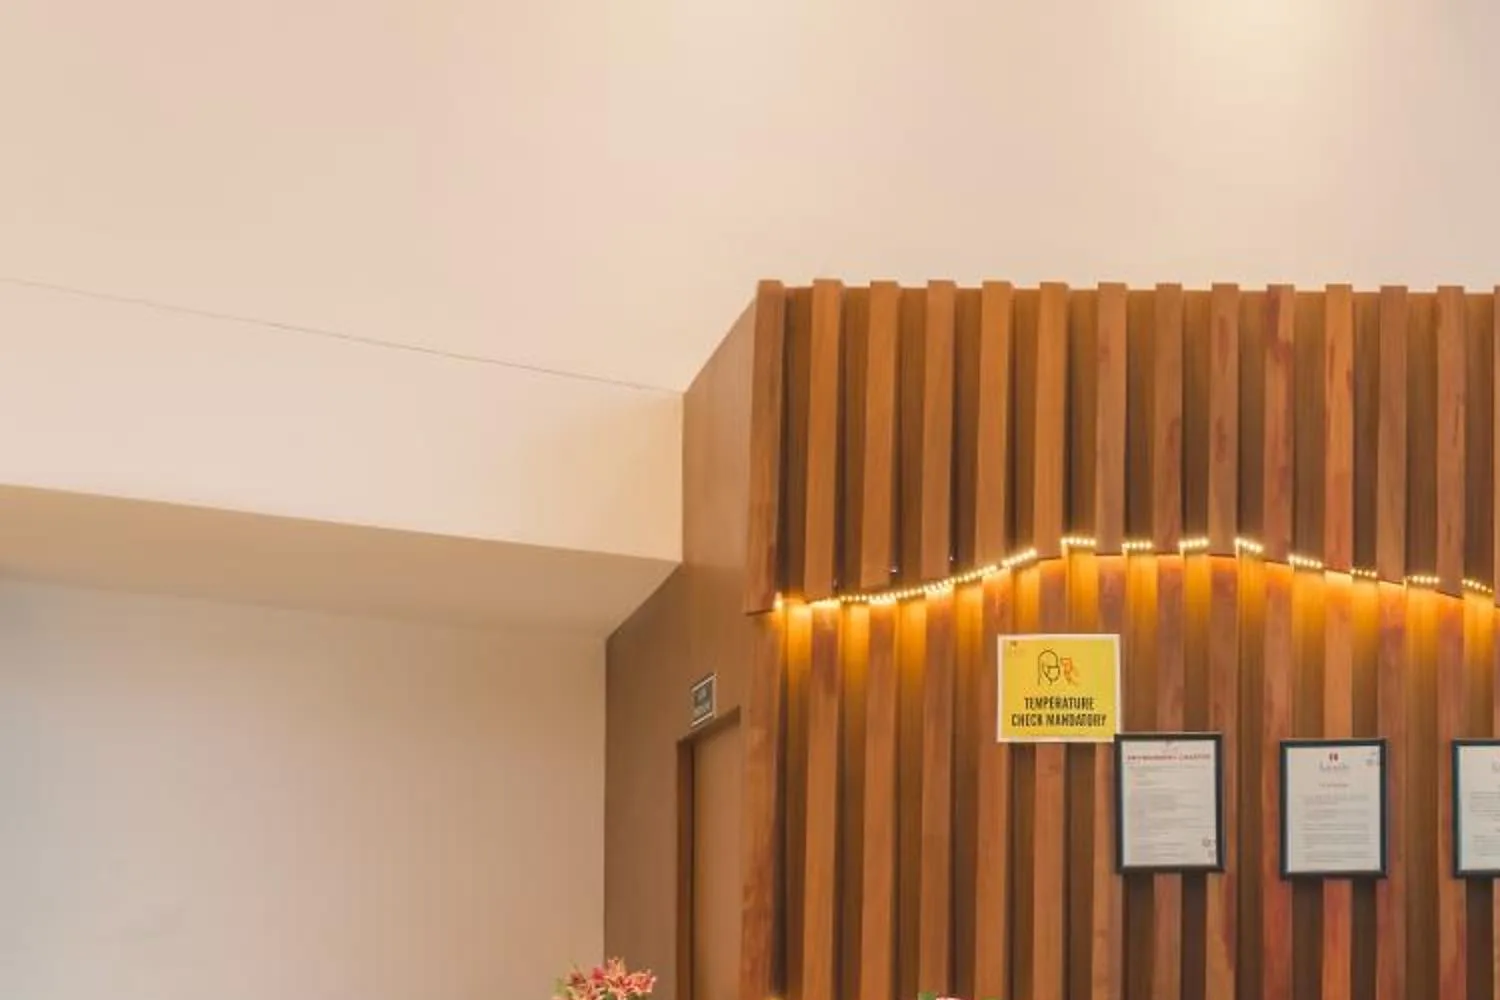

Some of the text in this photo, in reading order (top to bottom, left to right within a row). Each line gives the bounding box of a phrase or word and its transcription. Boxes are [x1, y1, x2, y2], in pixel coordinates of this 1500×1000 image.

[1024, 696, 1095, 710] TEMPERATURE
[1011, 713, 1107, 727] CHECK MANDATORY
